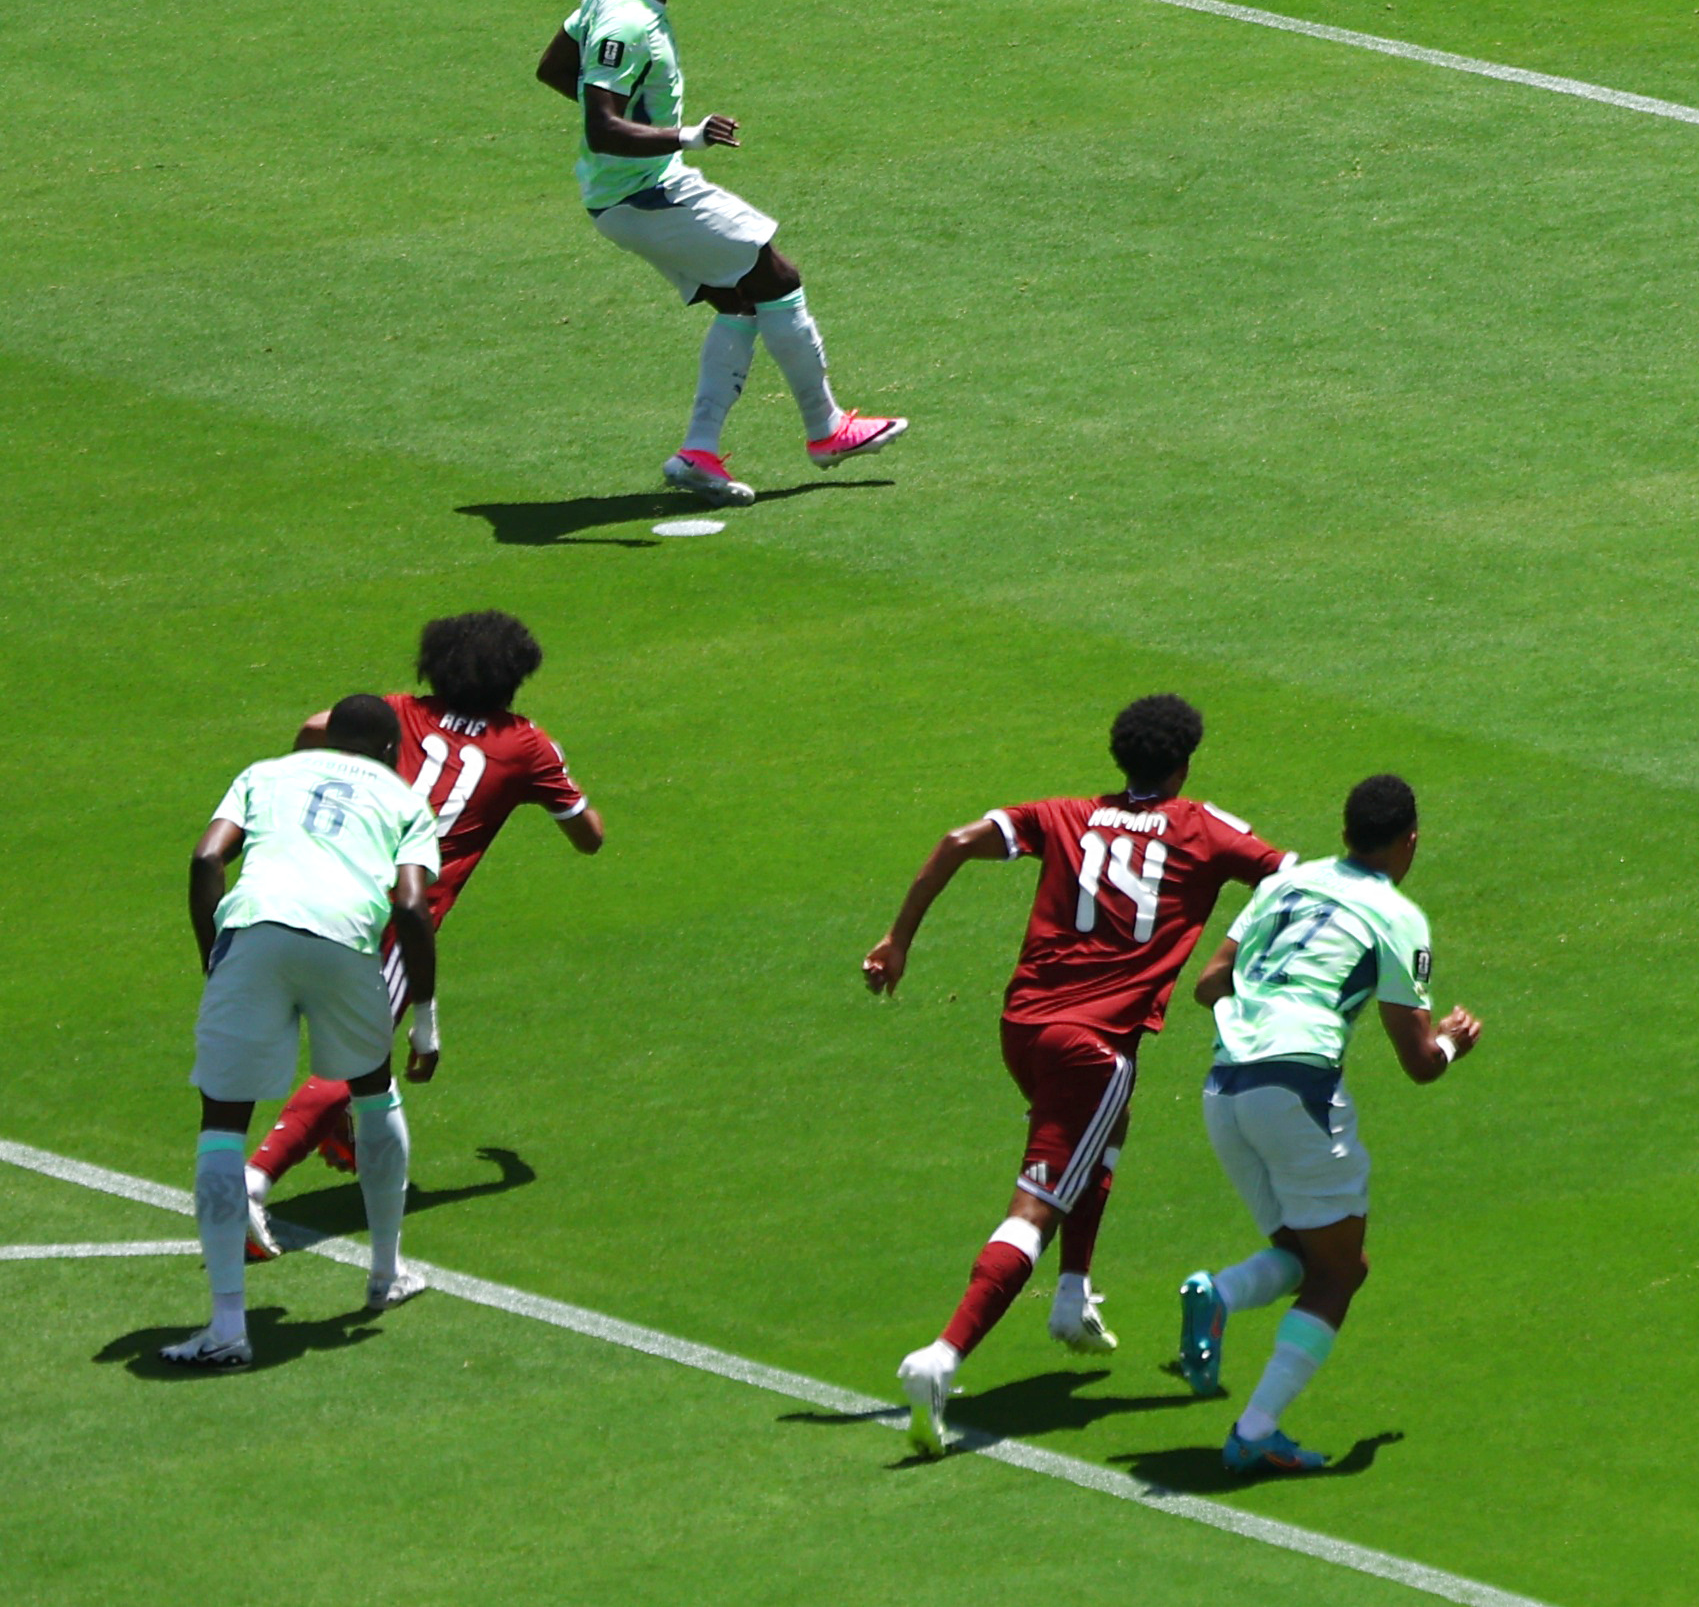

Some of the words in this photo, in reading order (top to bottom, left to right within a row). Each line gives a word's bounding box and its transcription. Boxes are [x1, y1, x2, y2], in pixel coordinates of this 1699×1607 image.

[439, 713, 489, 737] AFIF
[301, 779, 355, 838] 6
[411, 733, 487, 838] 11
[1088, 807, 1168, 836] HOMAM
[1075, 830, 1168, 944] 14
